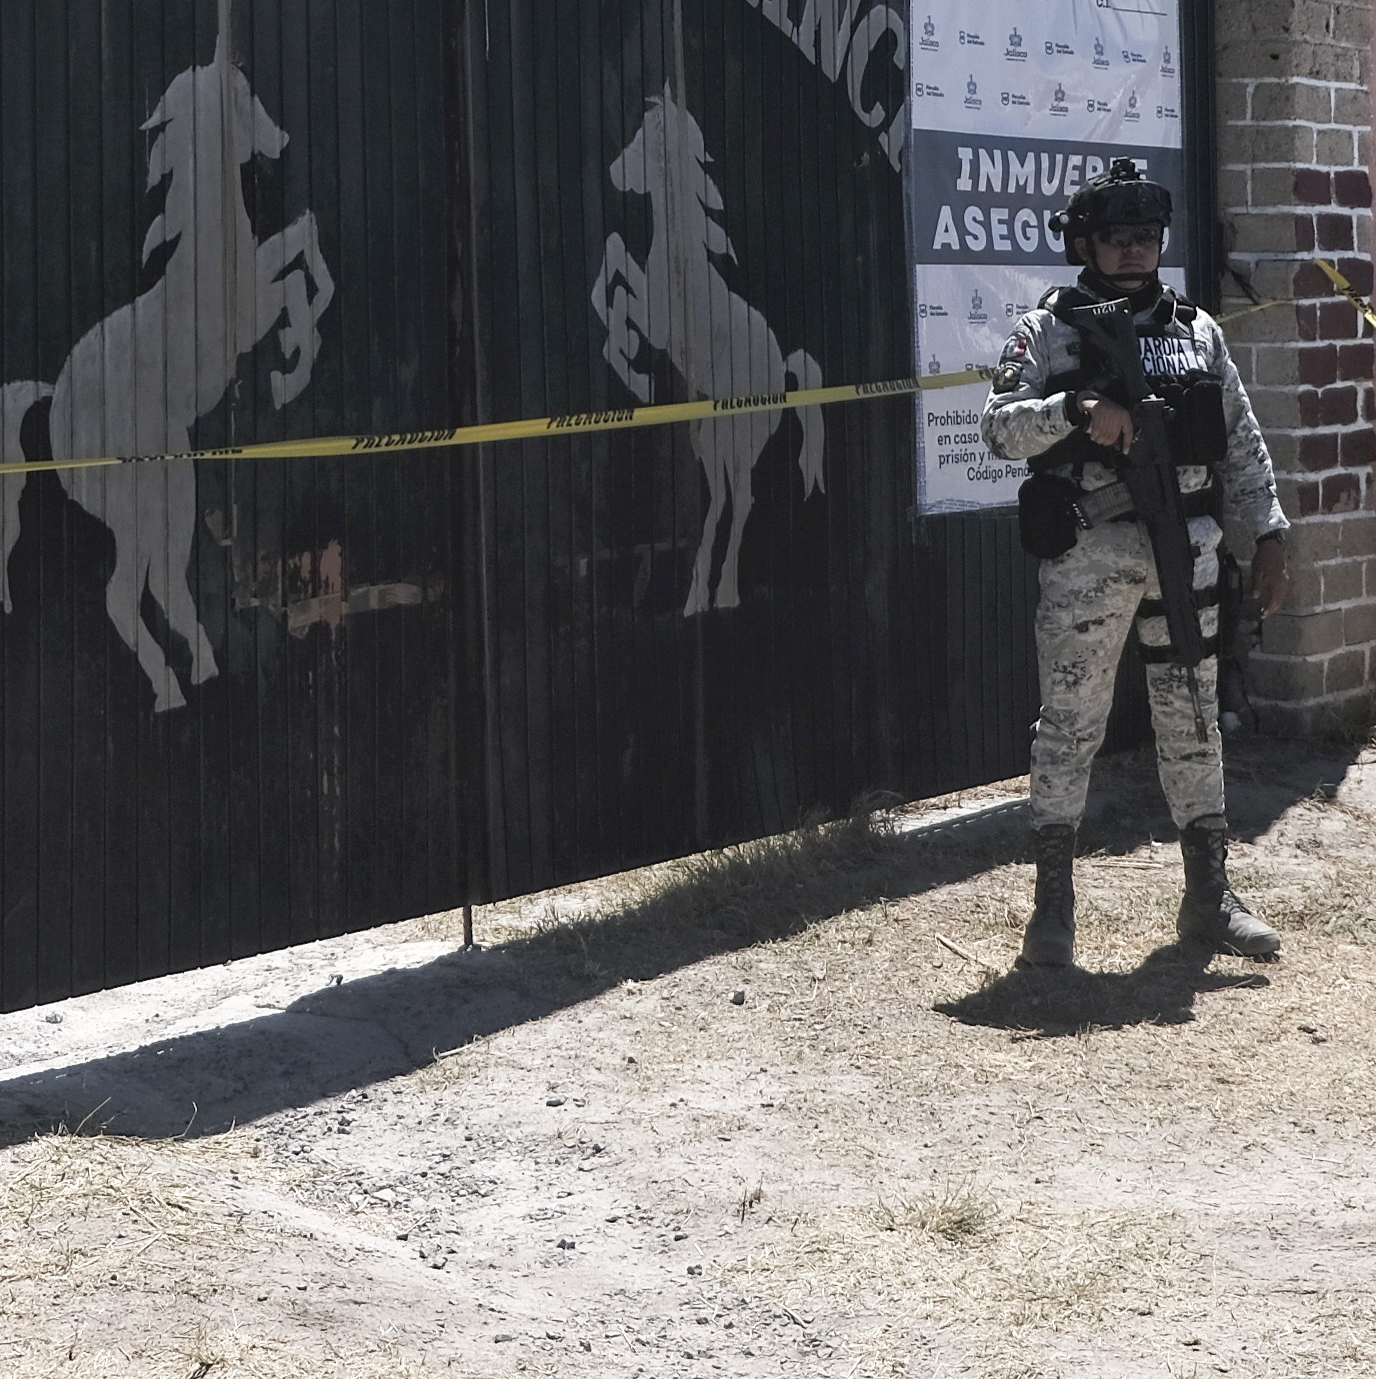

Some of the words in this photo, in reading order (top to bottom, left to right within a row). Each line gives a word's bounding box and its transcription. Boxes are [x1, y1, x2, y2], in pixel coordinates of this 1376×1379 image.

[956, 146, 1148, 197] INMUEB
[1138, 337, 1185, 356] ARDIA
[1141, 353, 1191, 375] CIONAL
[927, 409, 979, 427] Prohibido
[937, 433, 951, 445] en
[953, 432, 980, 445] caso
[938, 448, 976, 469] prisión
[978, 450, 985, 466] y
[967, 465, 1003, 483] Código
[1005, 464, 1031, 479] Pena
